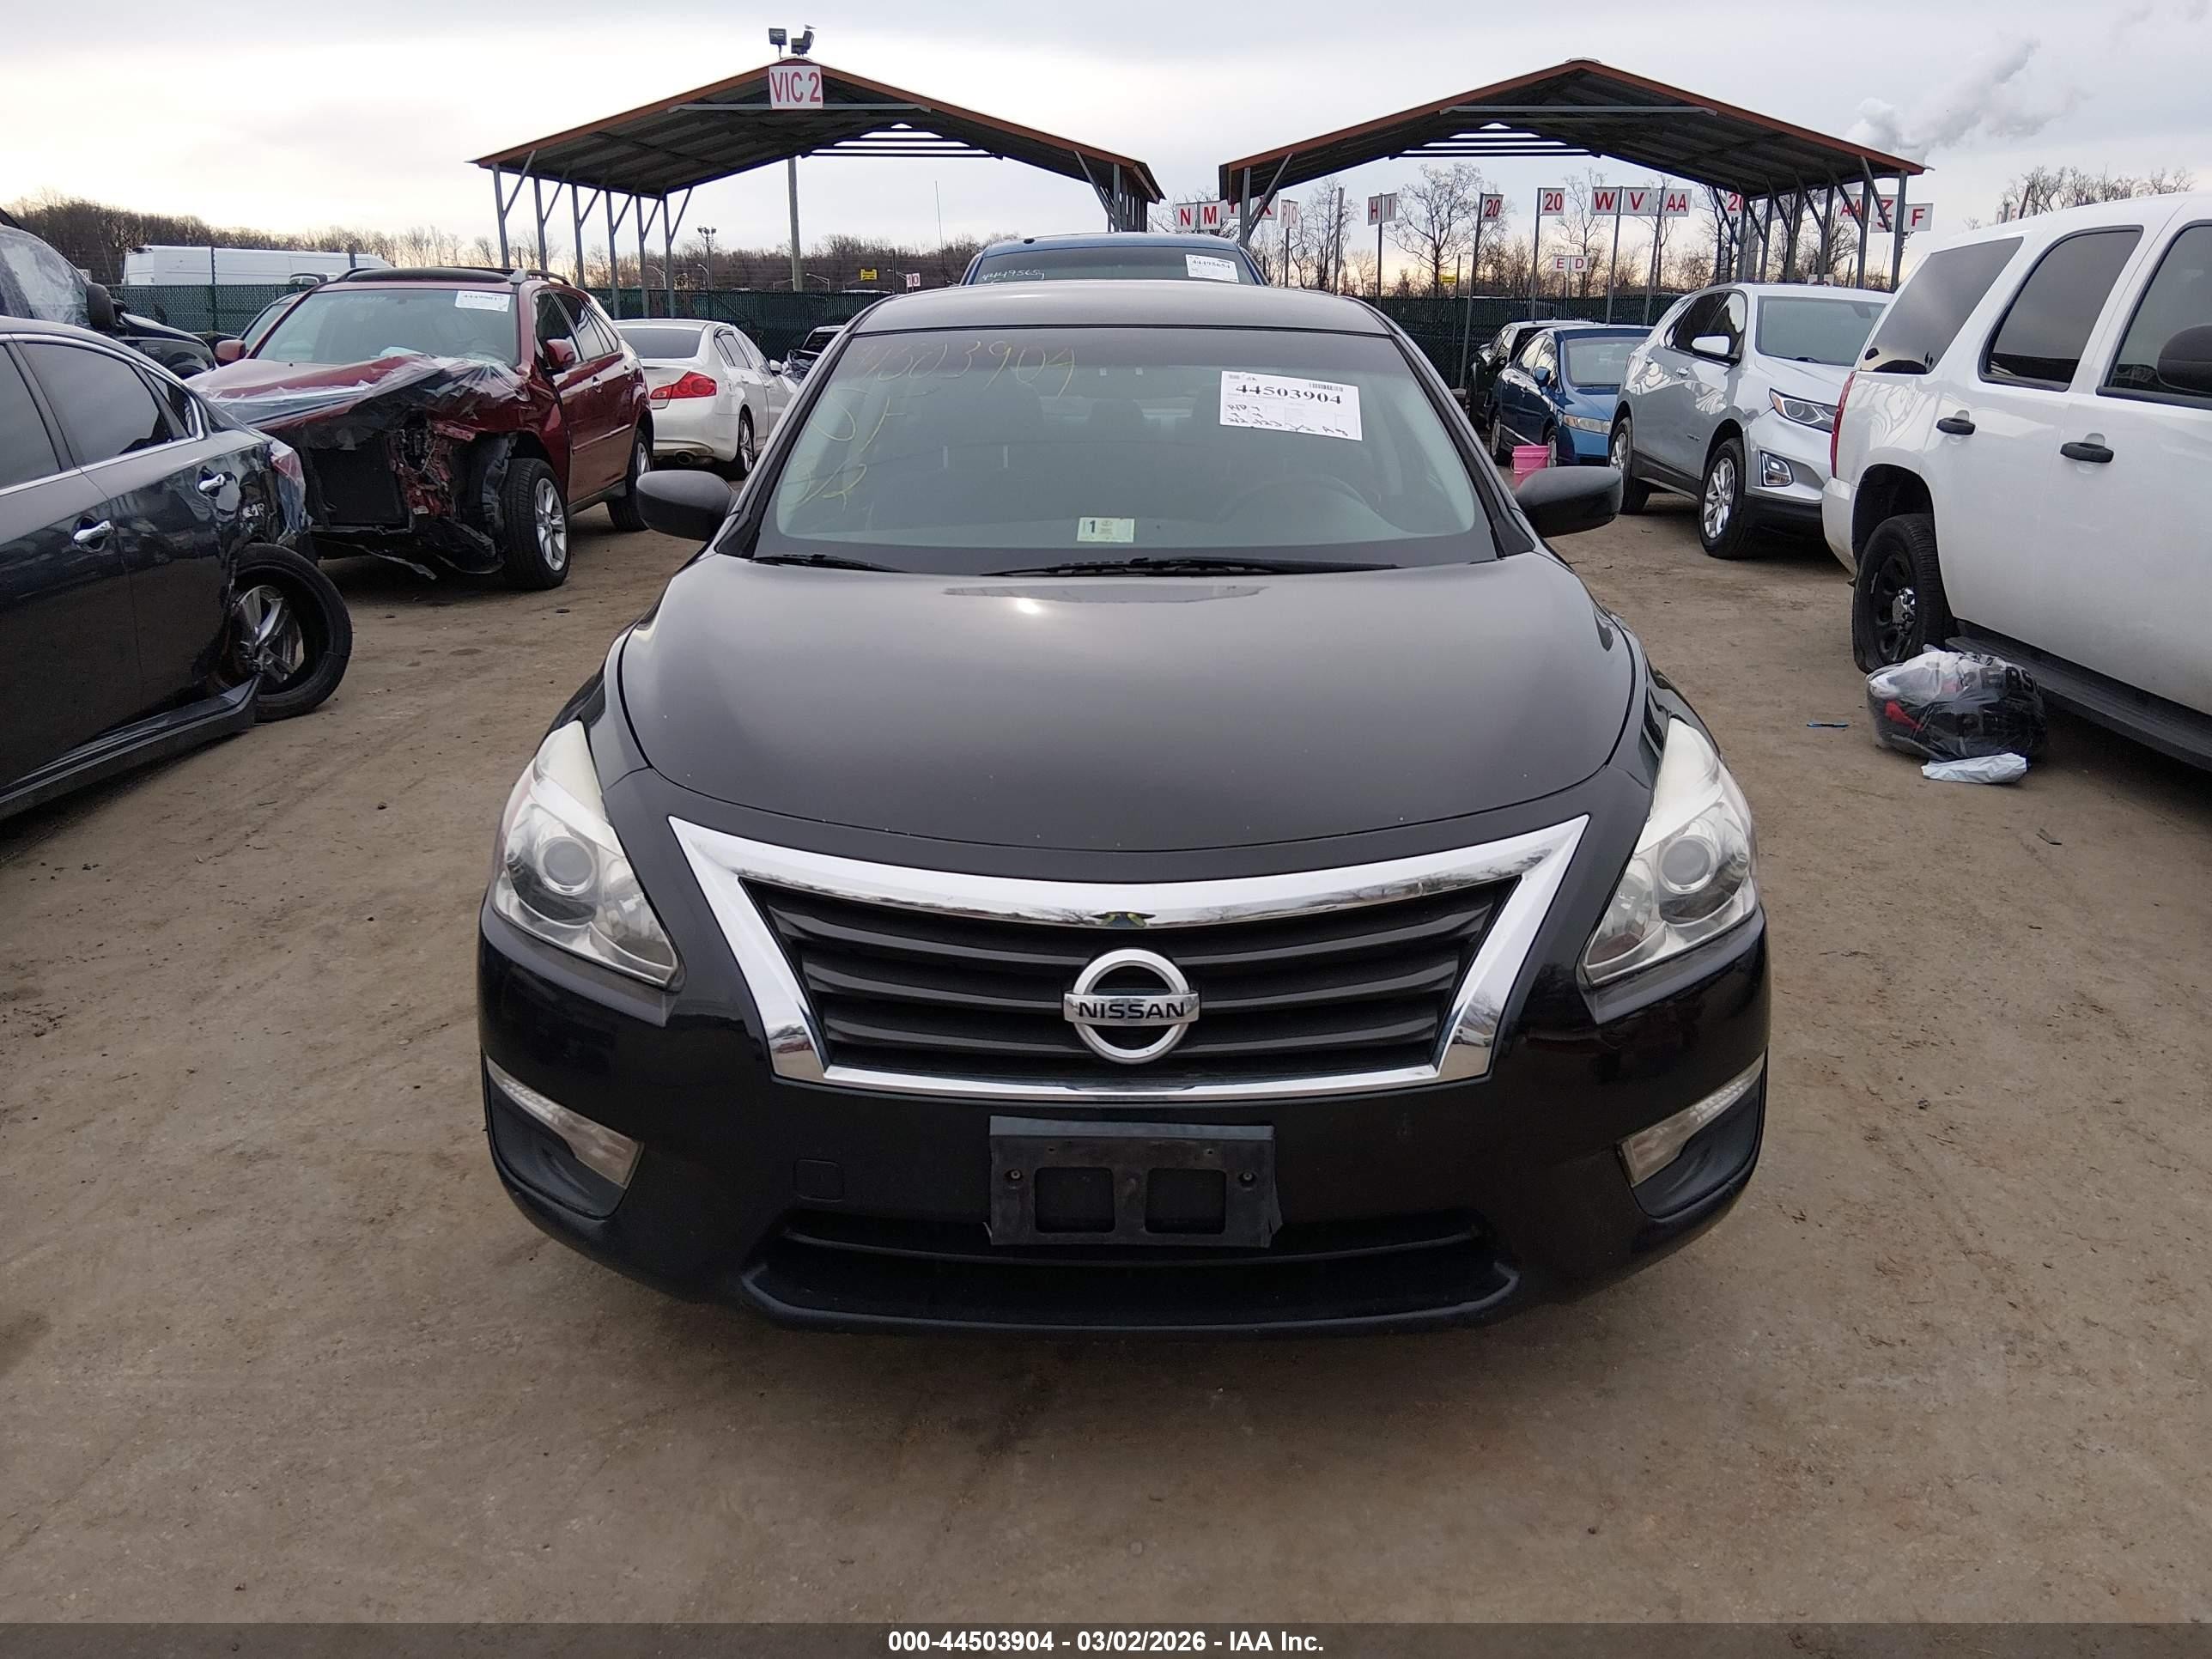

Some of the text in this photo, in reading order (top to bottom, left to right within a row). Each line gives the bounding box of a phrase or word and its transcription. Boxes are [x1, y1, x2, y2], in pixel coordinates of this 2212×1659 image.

[771, 72, 821, 102] VIC 2
[1486, 198, 1501, 217] 20
[1545, 192, 1563, 211] 20
[1595, 192, 1644, 210] W V
[1666, 194, 1687, 212] AA
[1180, 208, 1191, 226] N
[1203, 206, 1217, 224] M
[1282, 205, 1288, 221] P
[1370, 201, 1378, 221] H
[1911, 209, 1925, 227] F
[1557, 258, 1584, 269] E D
[1236, 384, 1341, 404] 44503904
[1089, 520, 1096, 533] 1
[1079, 1002, 1185, 1019] NISSAN
